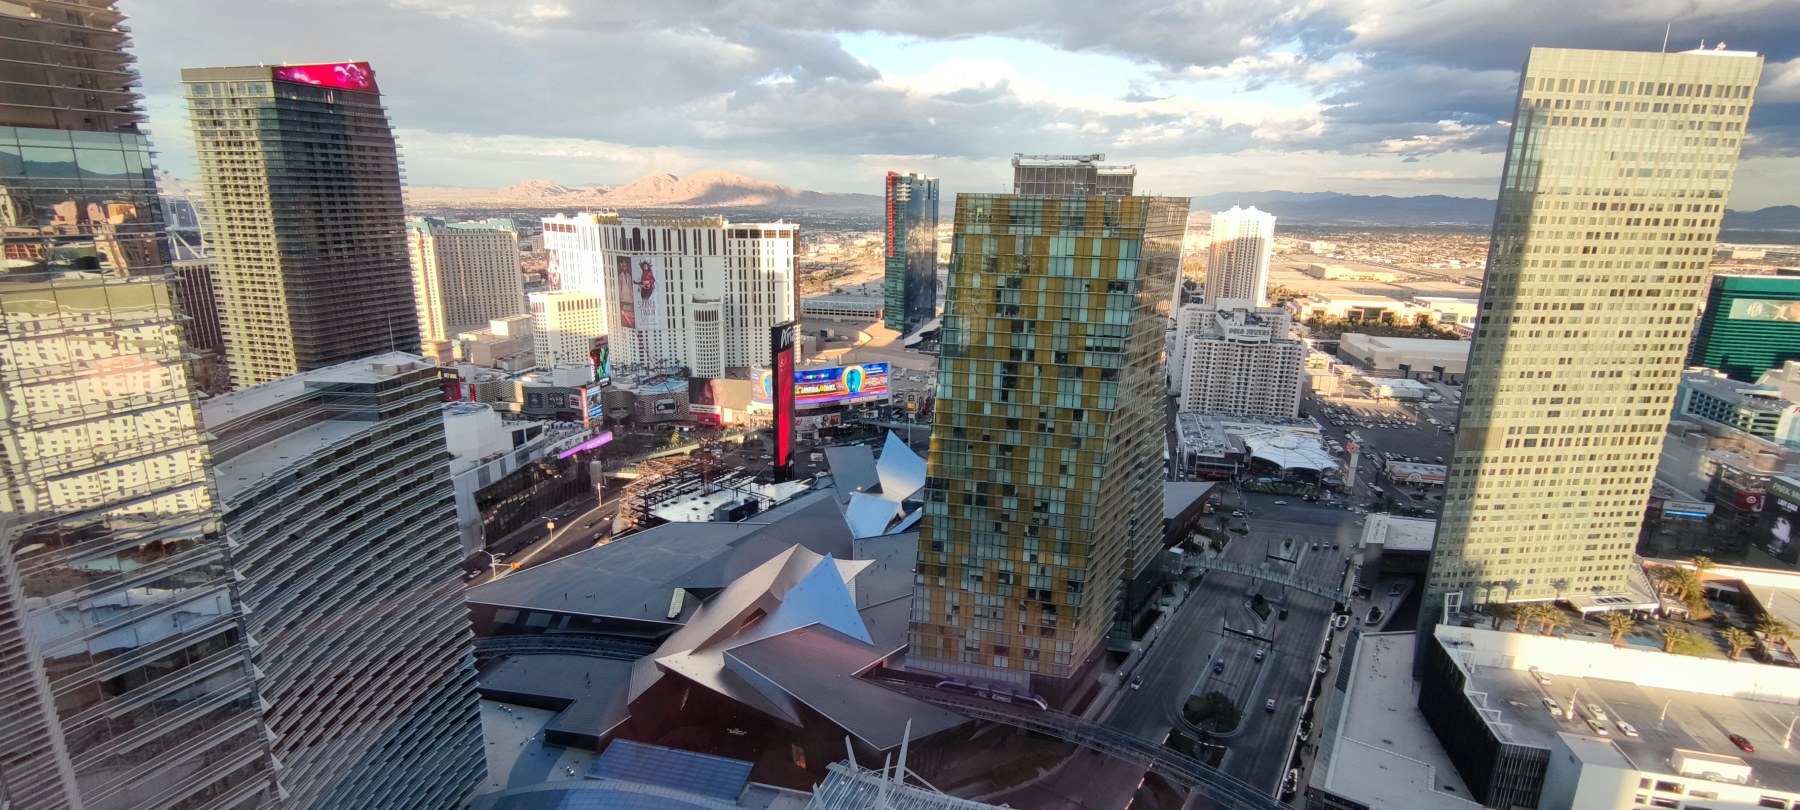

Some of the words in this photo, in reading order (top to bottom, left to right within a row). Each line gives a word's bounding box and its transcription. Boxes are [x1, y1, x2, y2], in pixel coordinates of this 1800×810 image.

[640, 309, 655, 317] TWAIN
[1229, 327, 1244, 335] POLO
[1246, 328, 1270, 336] TOWERS
[1773, 483, 1791, 496] PARK
